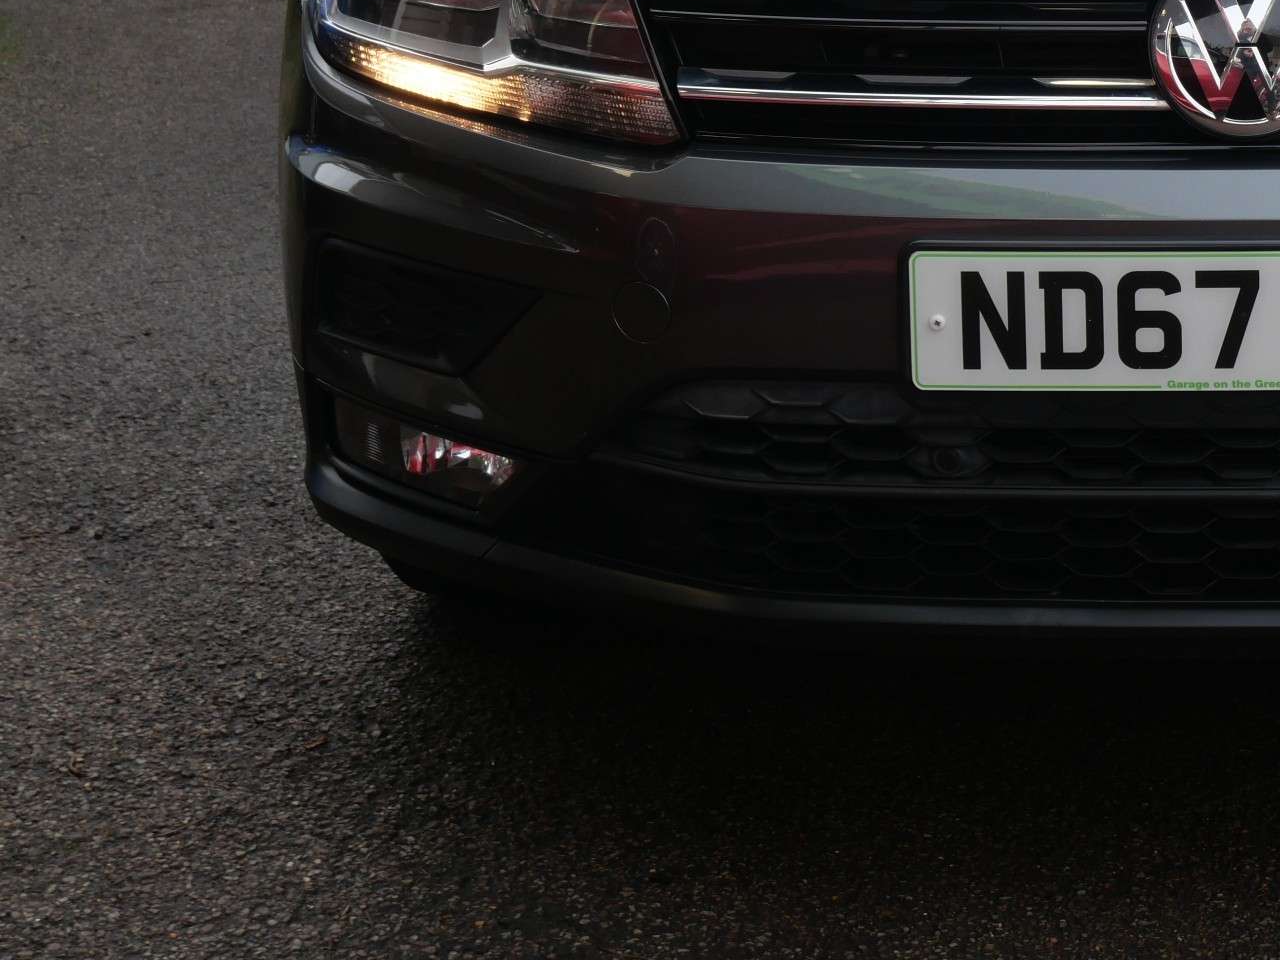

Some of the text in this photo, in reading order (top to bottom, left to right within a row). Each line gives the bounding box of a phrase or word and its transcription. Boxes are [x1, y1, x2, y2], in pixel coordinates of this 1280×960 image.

[960, 270, 1260, 370] ND67
[1167, 380, 1210, 390] Garage
[1213, 381, 1229, 389] on
[1232, 380, 1251, 389] the
